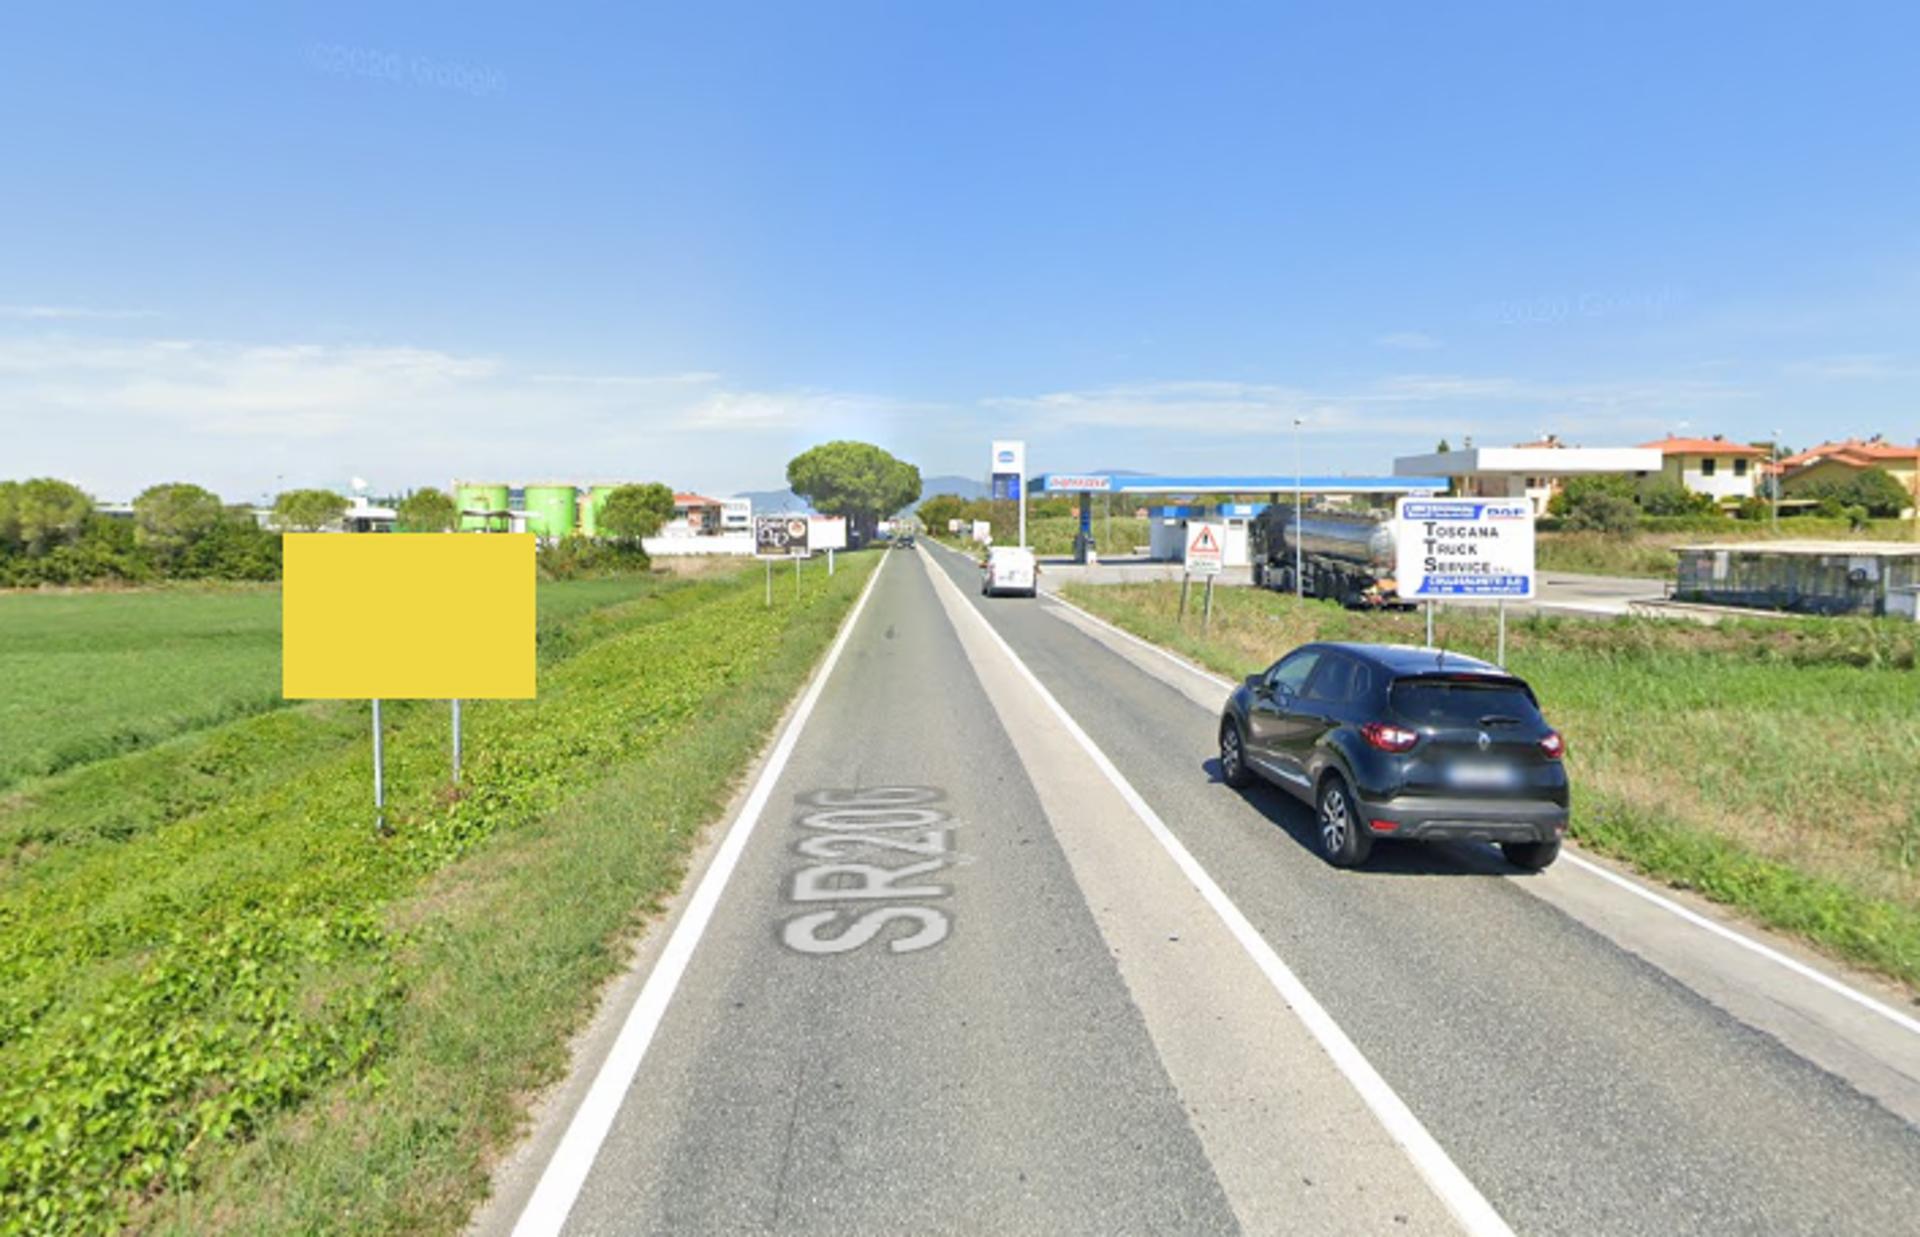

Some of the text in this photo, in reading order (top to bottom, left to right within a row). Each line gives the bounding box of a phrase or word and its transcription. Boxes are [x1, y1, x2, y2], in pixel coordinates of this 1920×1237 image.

[1423, 521, 1499, 538] TOSCANA
[1423, 539, 1478, 555] TRUCK
[1423, 557, 1490, 573] SERVICE
[784, 786, 949, 953] SR206
